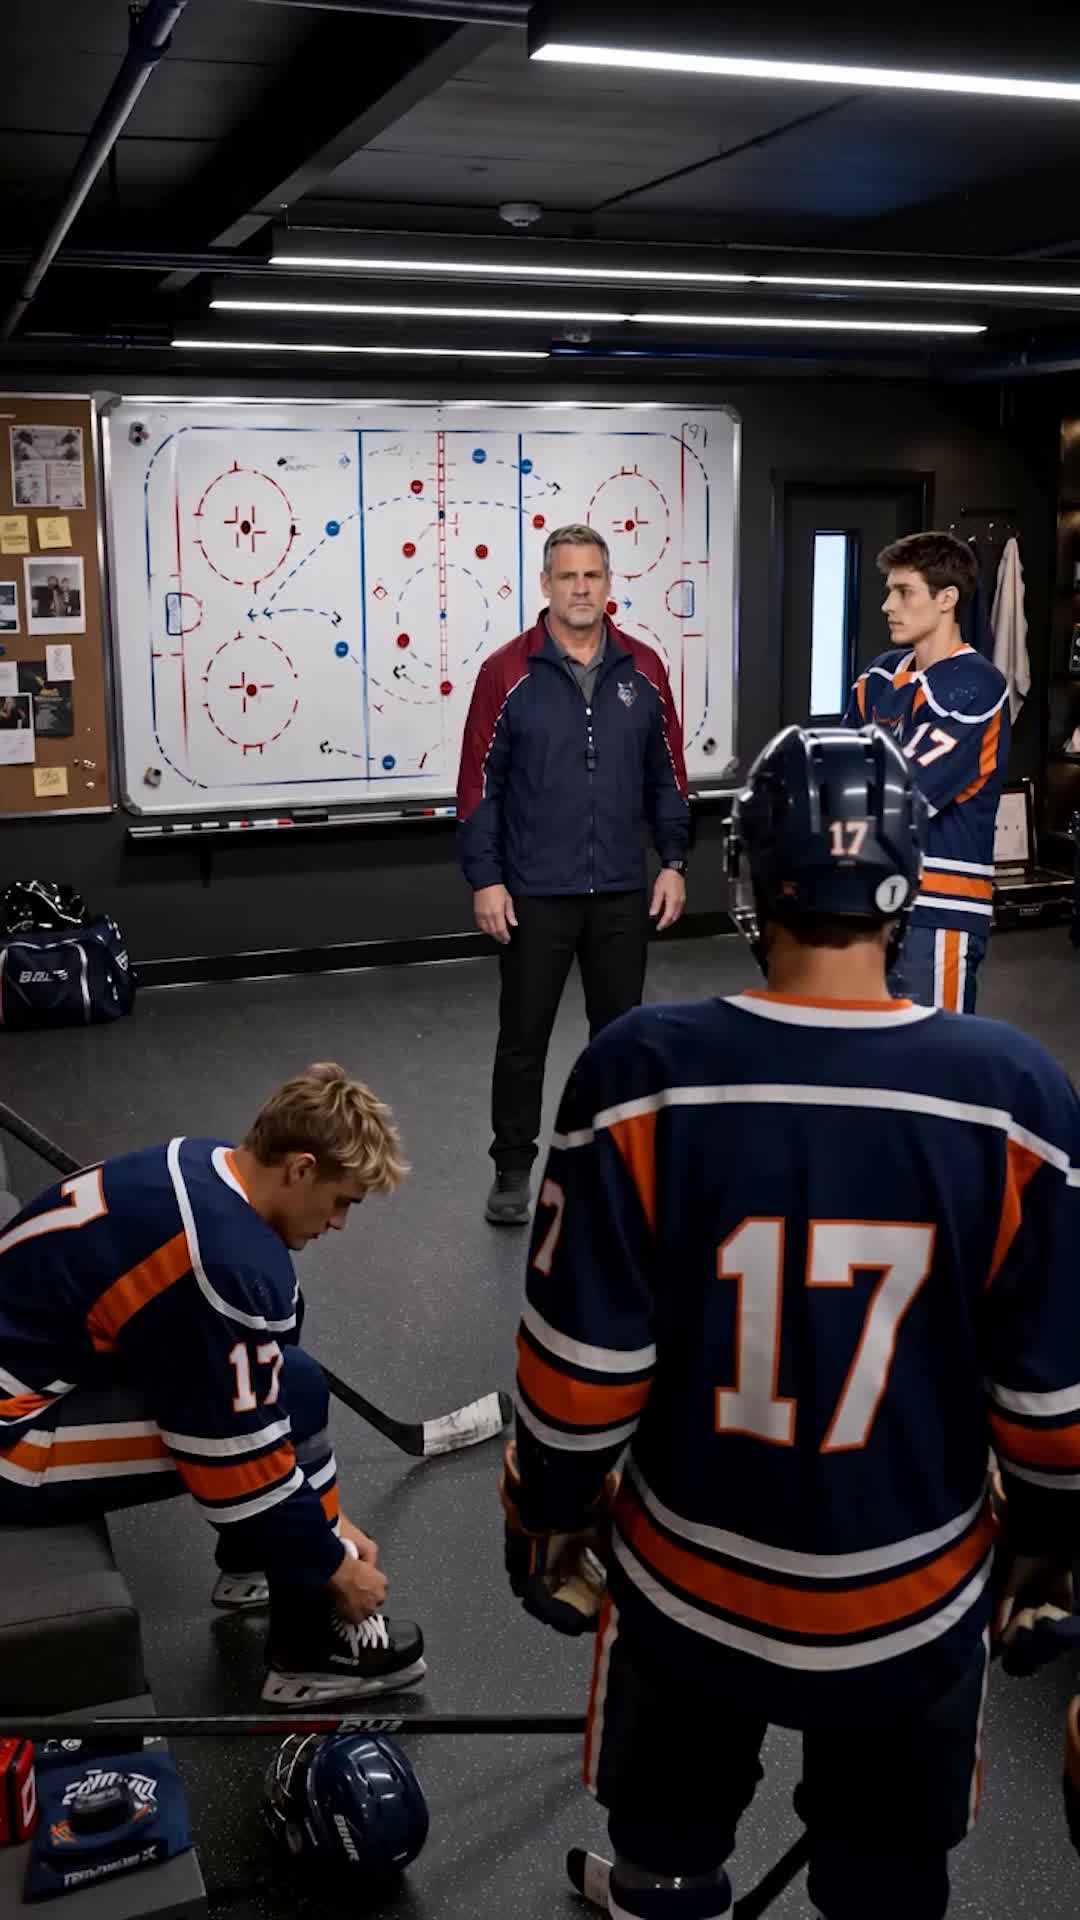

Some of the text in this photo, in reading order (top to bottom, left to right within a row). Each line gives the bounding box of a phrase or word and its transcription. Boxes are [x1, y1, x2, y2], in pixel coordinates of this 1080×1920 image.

[903, 722, 958, 768] 17
[829, 821, 869, 857] 17
[714, 1215, 937, 1453] 17
[228, 1341, 284, 1413] 17
